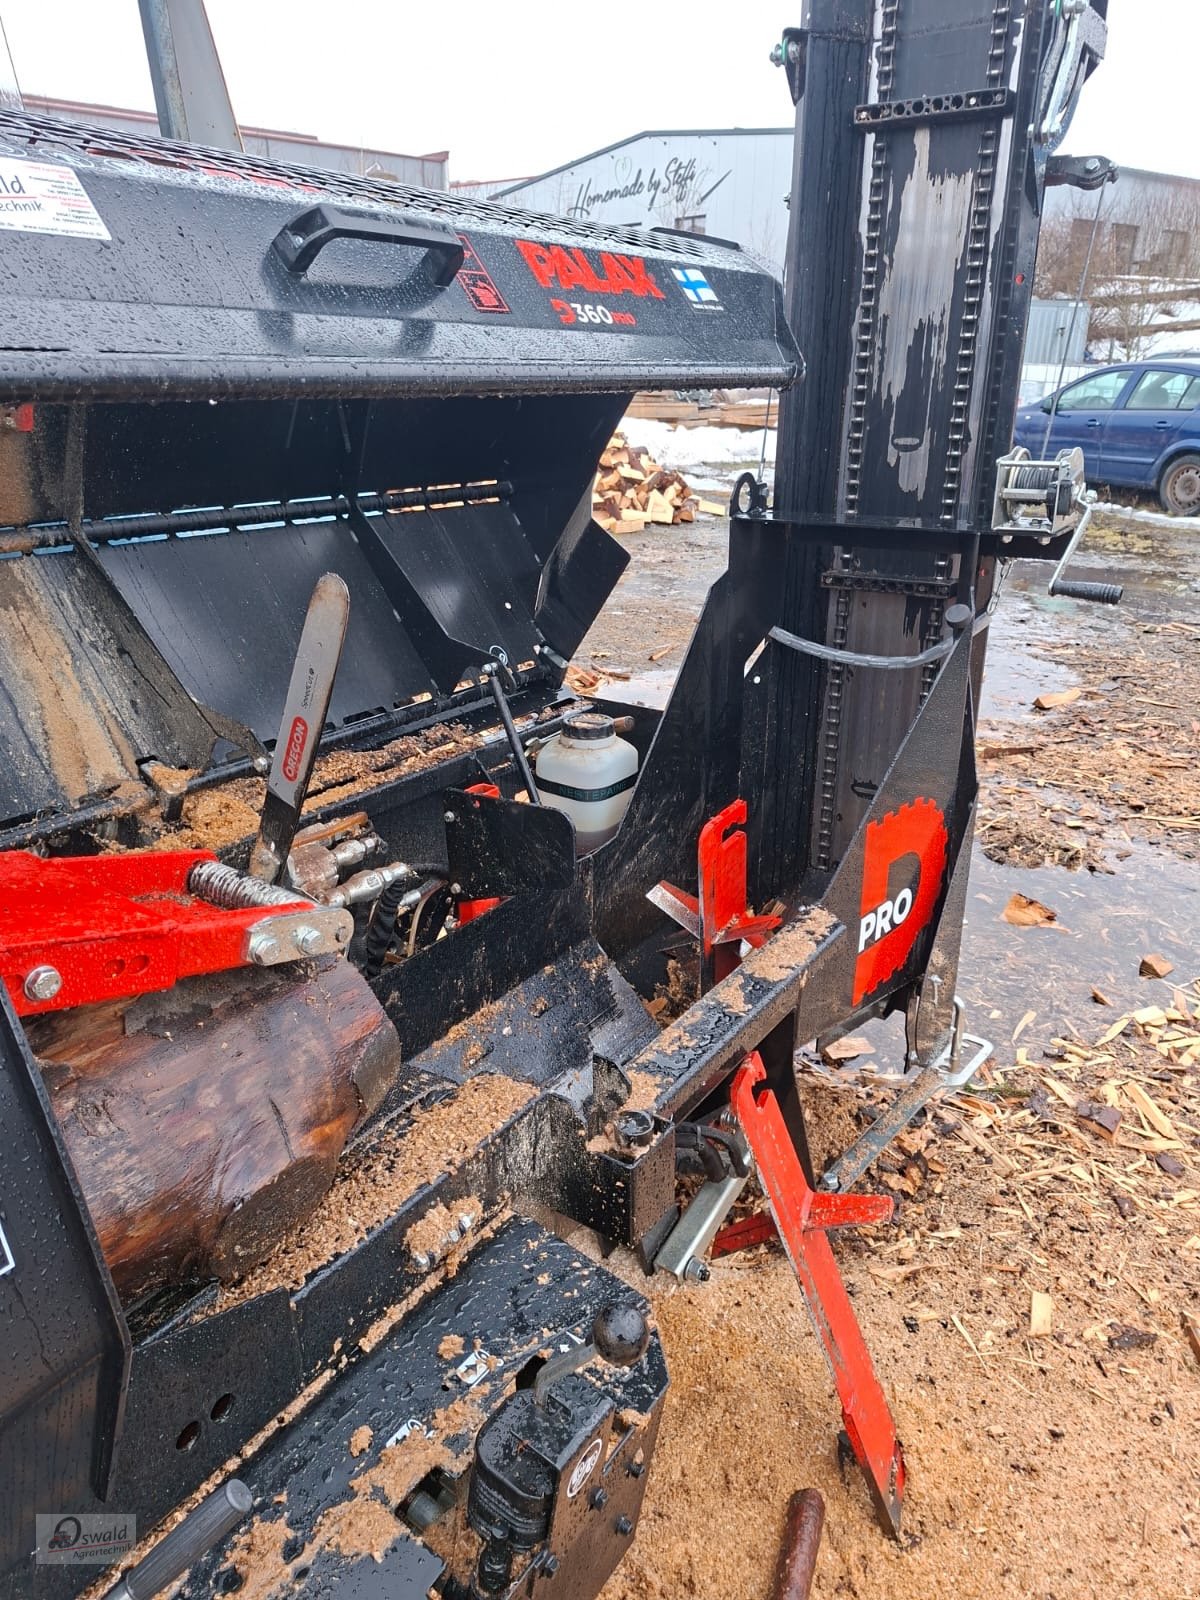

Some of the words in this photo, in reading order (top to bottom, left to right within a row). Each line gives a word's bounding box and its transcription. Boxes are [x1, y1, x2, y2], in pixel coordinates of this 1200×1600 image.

[567, 168, 645, 218] Homemade
[647, 168, 661, 212] by
[662, 157, 697, 202] Steffi
[515, 239, 667, 300] PALAX
[285, 721, 306, 779] OREGON
[857, 887, 913, 953] PRO
